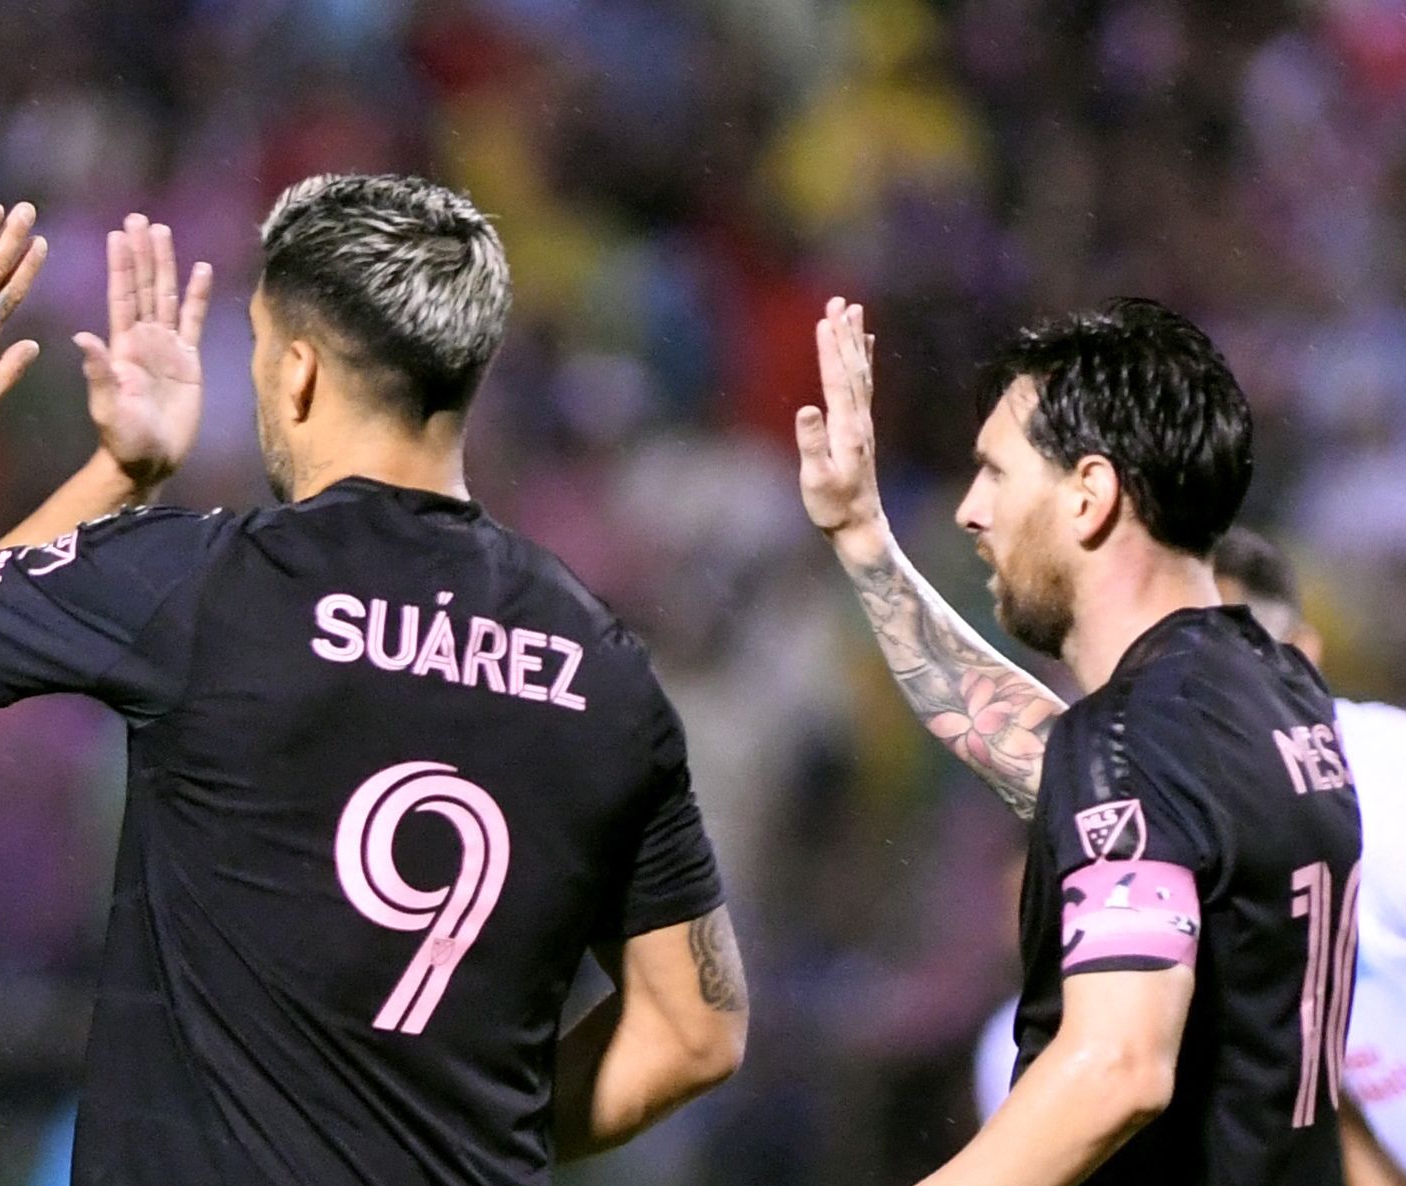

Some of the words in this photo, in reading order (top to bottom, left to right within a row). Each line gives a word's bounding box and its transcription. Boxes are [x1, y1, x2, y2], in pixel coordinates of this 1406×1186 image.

[311, 591, 586, 711] SUÁREZ
[1272, 723, 1354, 794] MES
[334, 761, 510, 1034] 9
